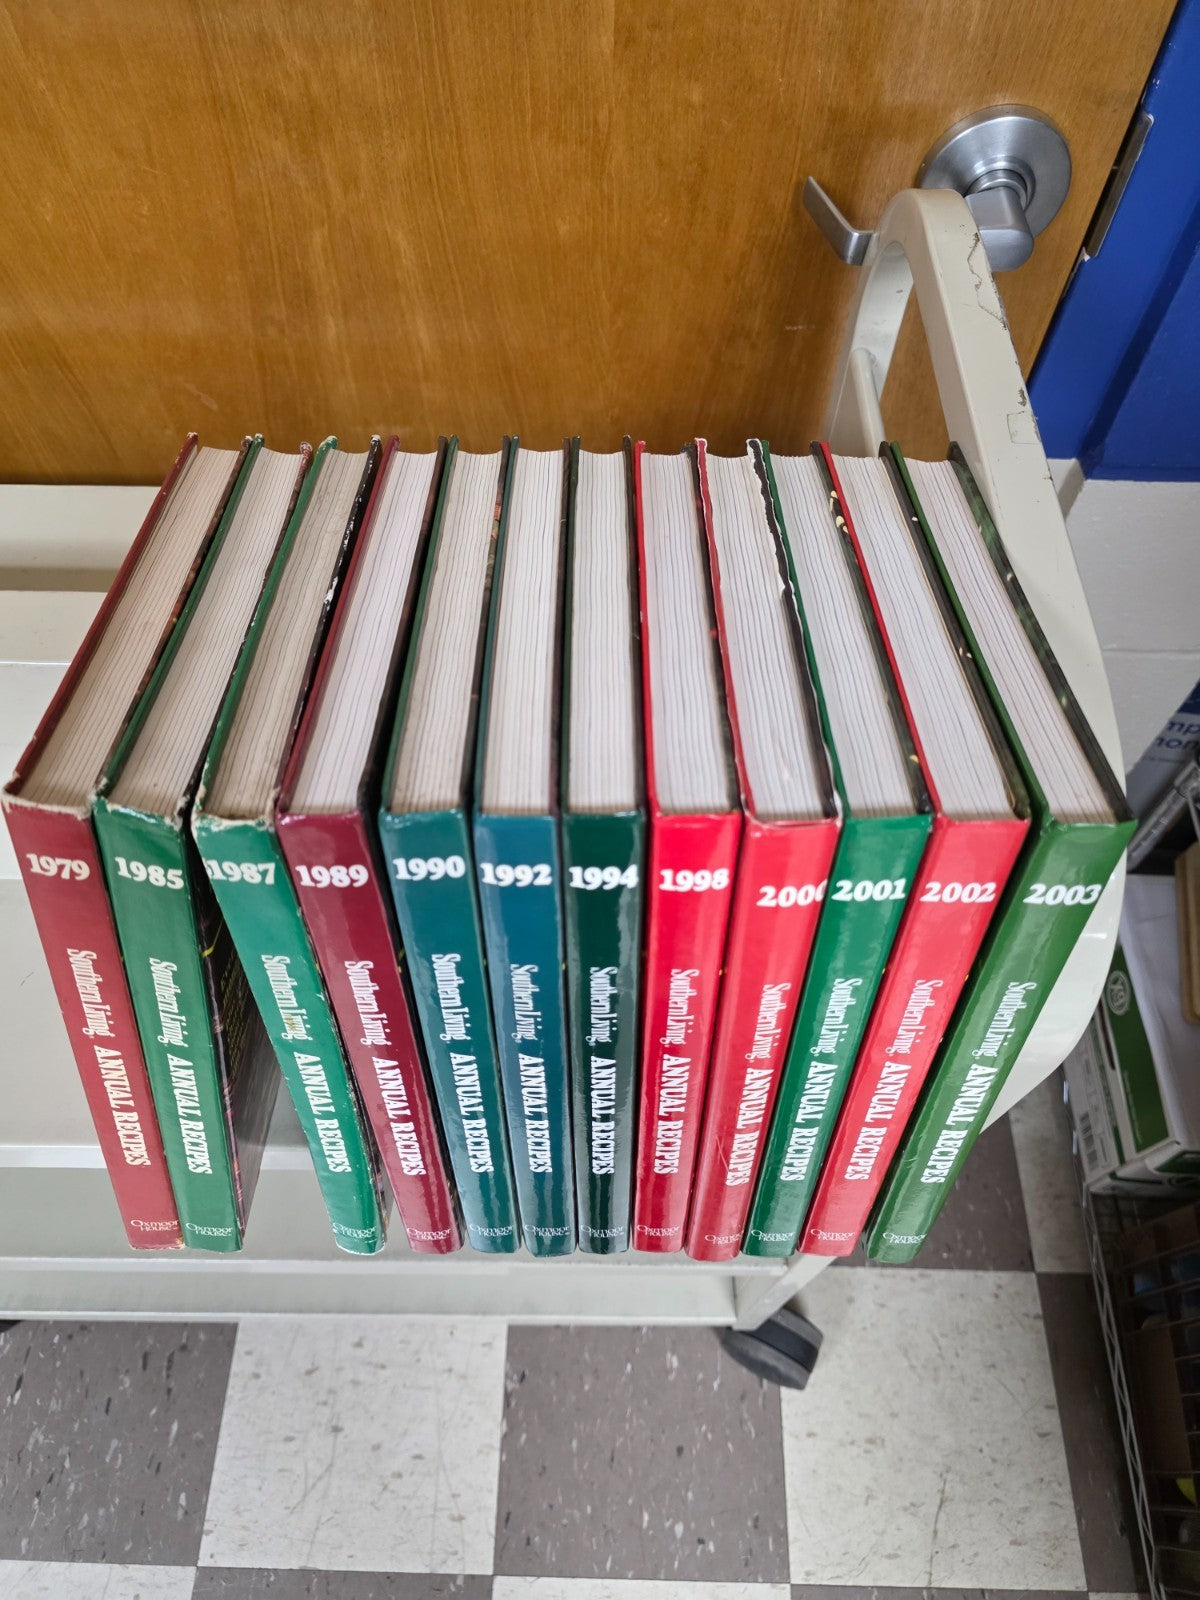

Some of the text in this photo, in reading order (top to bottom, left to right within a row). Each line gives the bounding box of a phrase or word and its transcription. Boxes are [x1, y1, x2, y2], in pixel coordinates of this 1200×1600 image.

[26, 853, 91, 881] 1979
[114, 856, 185, 890] 1985
[203, 859, 276, 886] 1987
[294, 864, 370, 889] 1989
[392, 855, 466, 881] 1990
[479, 863, 553, 888] 1992
[568, 864, 639, 891] 1994
[658, 867, 730, 893] 1998
[831, 878, 906, 902] 2001
[919, 880, 997, 904] 2002
[1023, 883, 1102, 906] 2003
[94, 1045, 135, 1109] ANNUAL
[167, 1053, 201, 1117] ANNUAL
[372, 1056, 411, 1119] ANNUAL
[449, 1052, 484, 1116] ANNUAL
[518, 1052, 548, 1116] ANNUAL
[590, 1055, 617, 1118] ANNUAL
[658, 1053, 692, 1117] ANNUAL
[736, 1067, 774, 1130] ANNUAL
[795, 1060, 838, 1123] ANNUAL
[864, 1060, 912, 1122] ANNUAL
[945, 1063, 998, 1126] ANNUAL
[112, 1106, 151, 1167] RECIPES
[293, 1051, 336, 1115] ANNUAL
[315, 1117, 352, 1173] RECIPES
[179, 1116, 213, 1175] RECIPES
[389, 1121, 427, 1176] RECIPES
[462, 1118, 494, 1174] RECIPES
[525, 1118, 553, 1173] RECIPES
[591, 1120, 615, 1175] RECIPES
[653, 1119, 684, 1175] RECIPES
[725, 1129, 760, 1187] RECIPES
[780, 1126, 820, 1182] RECIPES
[844, 1126, 888, 1181] RECIPES
[920, 1129, 968, 1184] RECIPES
